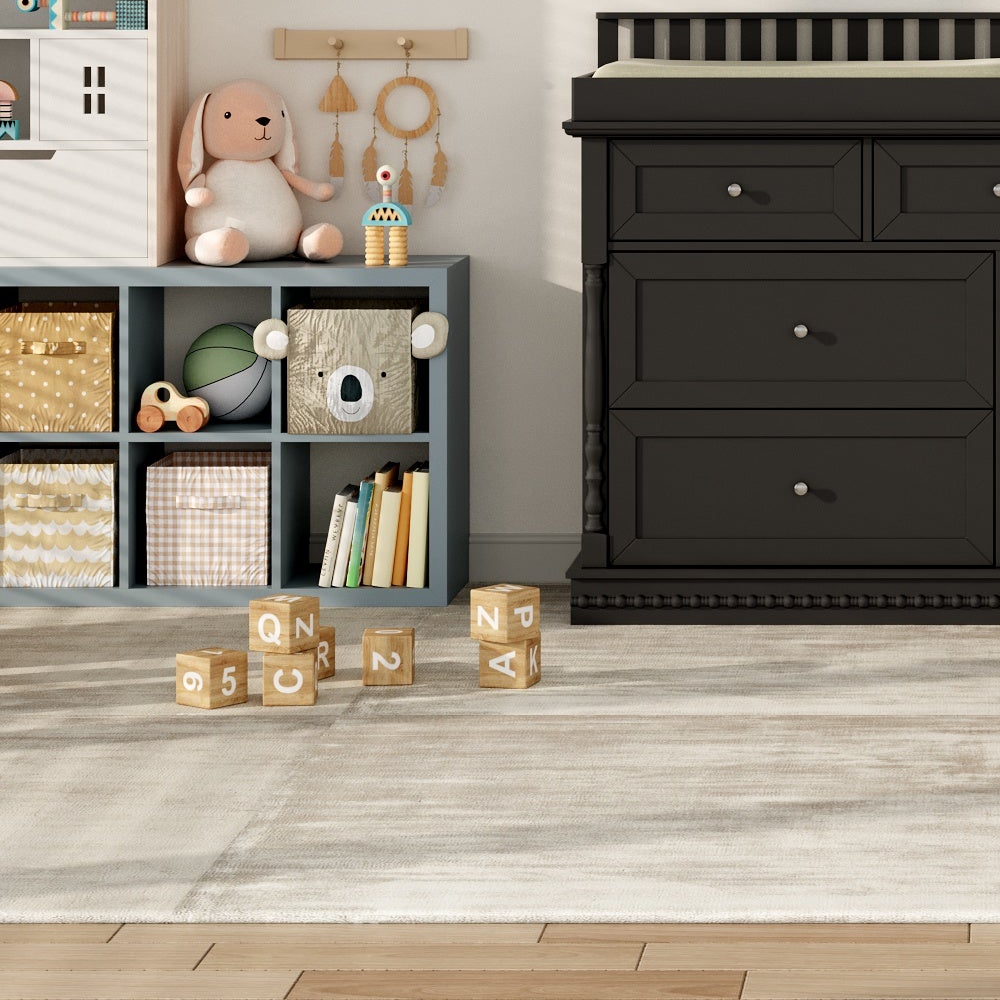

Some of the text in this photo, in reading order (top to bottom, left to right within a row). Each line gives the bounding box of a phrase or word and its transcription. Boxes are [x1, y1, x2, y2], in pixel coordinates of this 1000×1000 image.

[257, 613, 282, 646] Q
[513, 605, 534, 628] P
[317, 641, 330, 670] R
[372, 651, 401, 671] 2
[488, 650, 516, 678] A
[529, 645, 538, 676] K
[221, 666, 236, 697] 5
[273, 668, 304, 694] C
